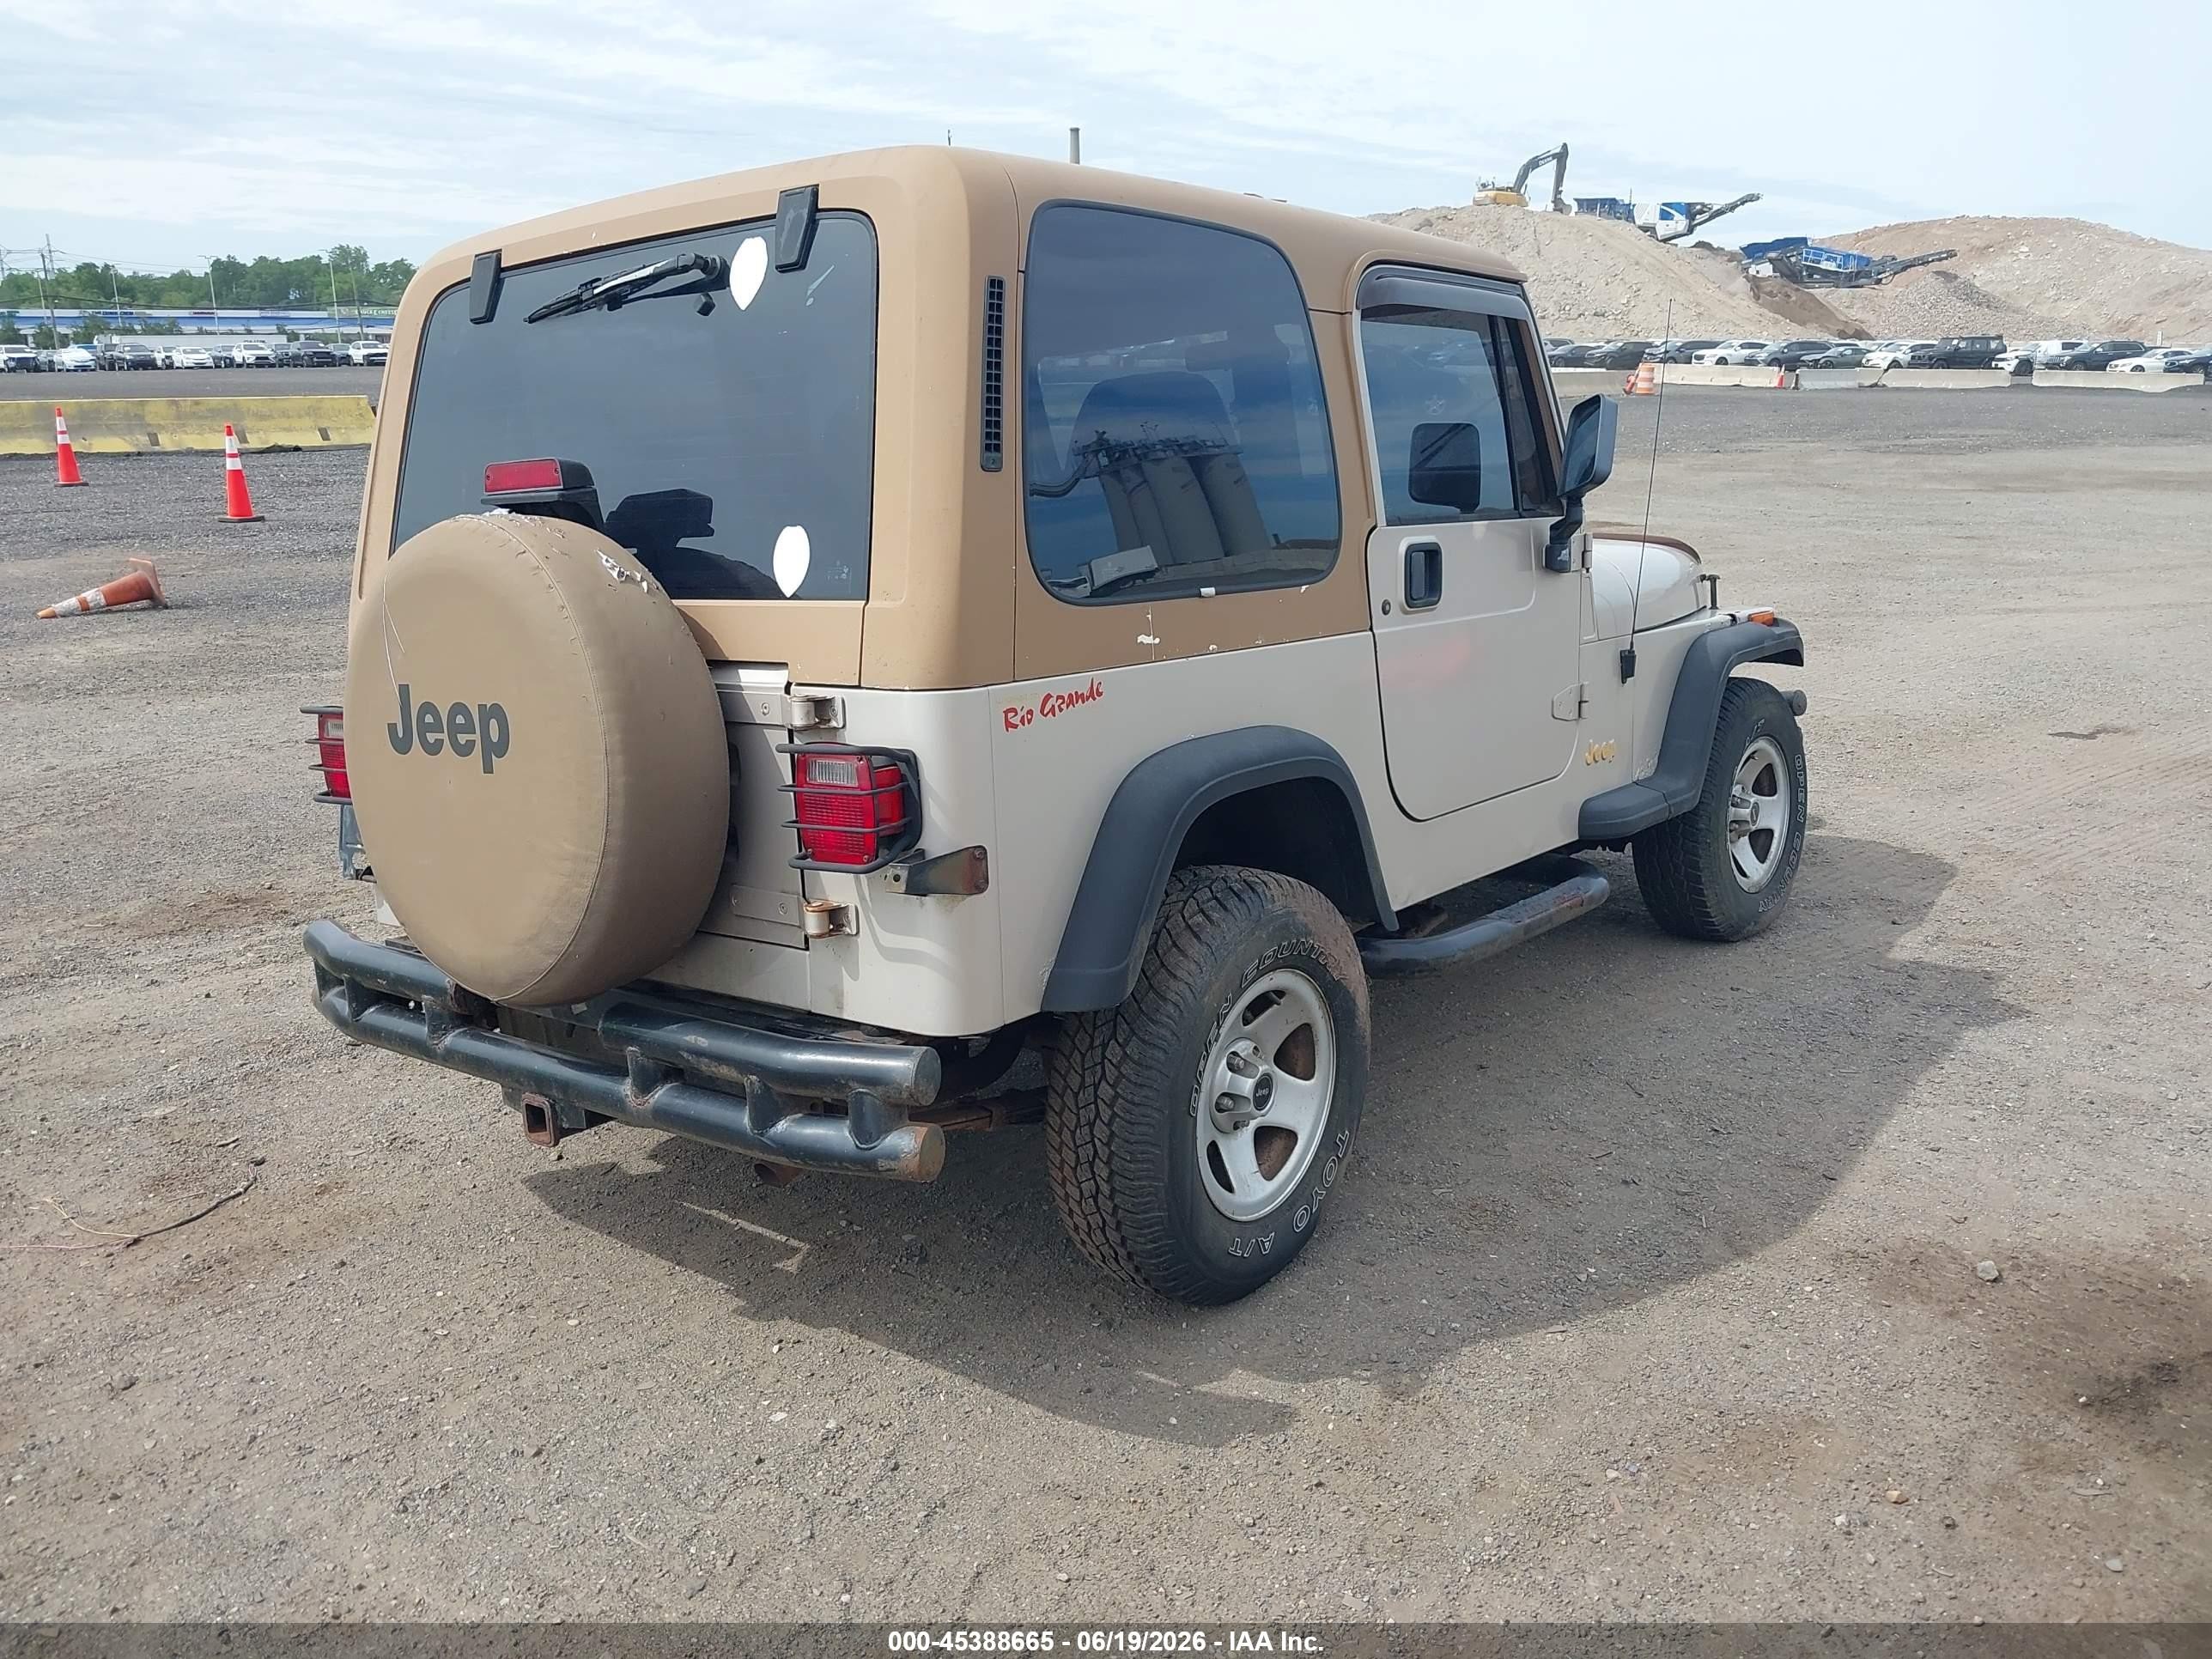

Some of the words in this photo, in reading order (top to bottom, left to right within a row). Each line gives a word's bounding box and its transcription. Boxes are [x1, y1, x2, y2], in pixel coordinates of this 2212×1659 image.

[387, 684, 510, 775] Jeep
[1002, 705, 1035, 732] Rio
[1039, 677, 1104, 718] Grande
[1795, 754, 1805, 823] OPEN
[1759, 831, 1802, 914] COUNTRY
[1189, 993, 1233, 1118] OPEN
[1241, 938, 1348, 988] COUNTRY
[1292, 1130, 1351, 1233] TOYO
[1228, 1231, 1275, 1259] A/T
